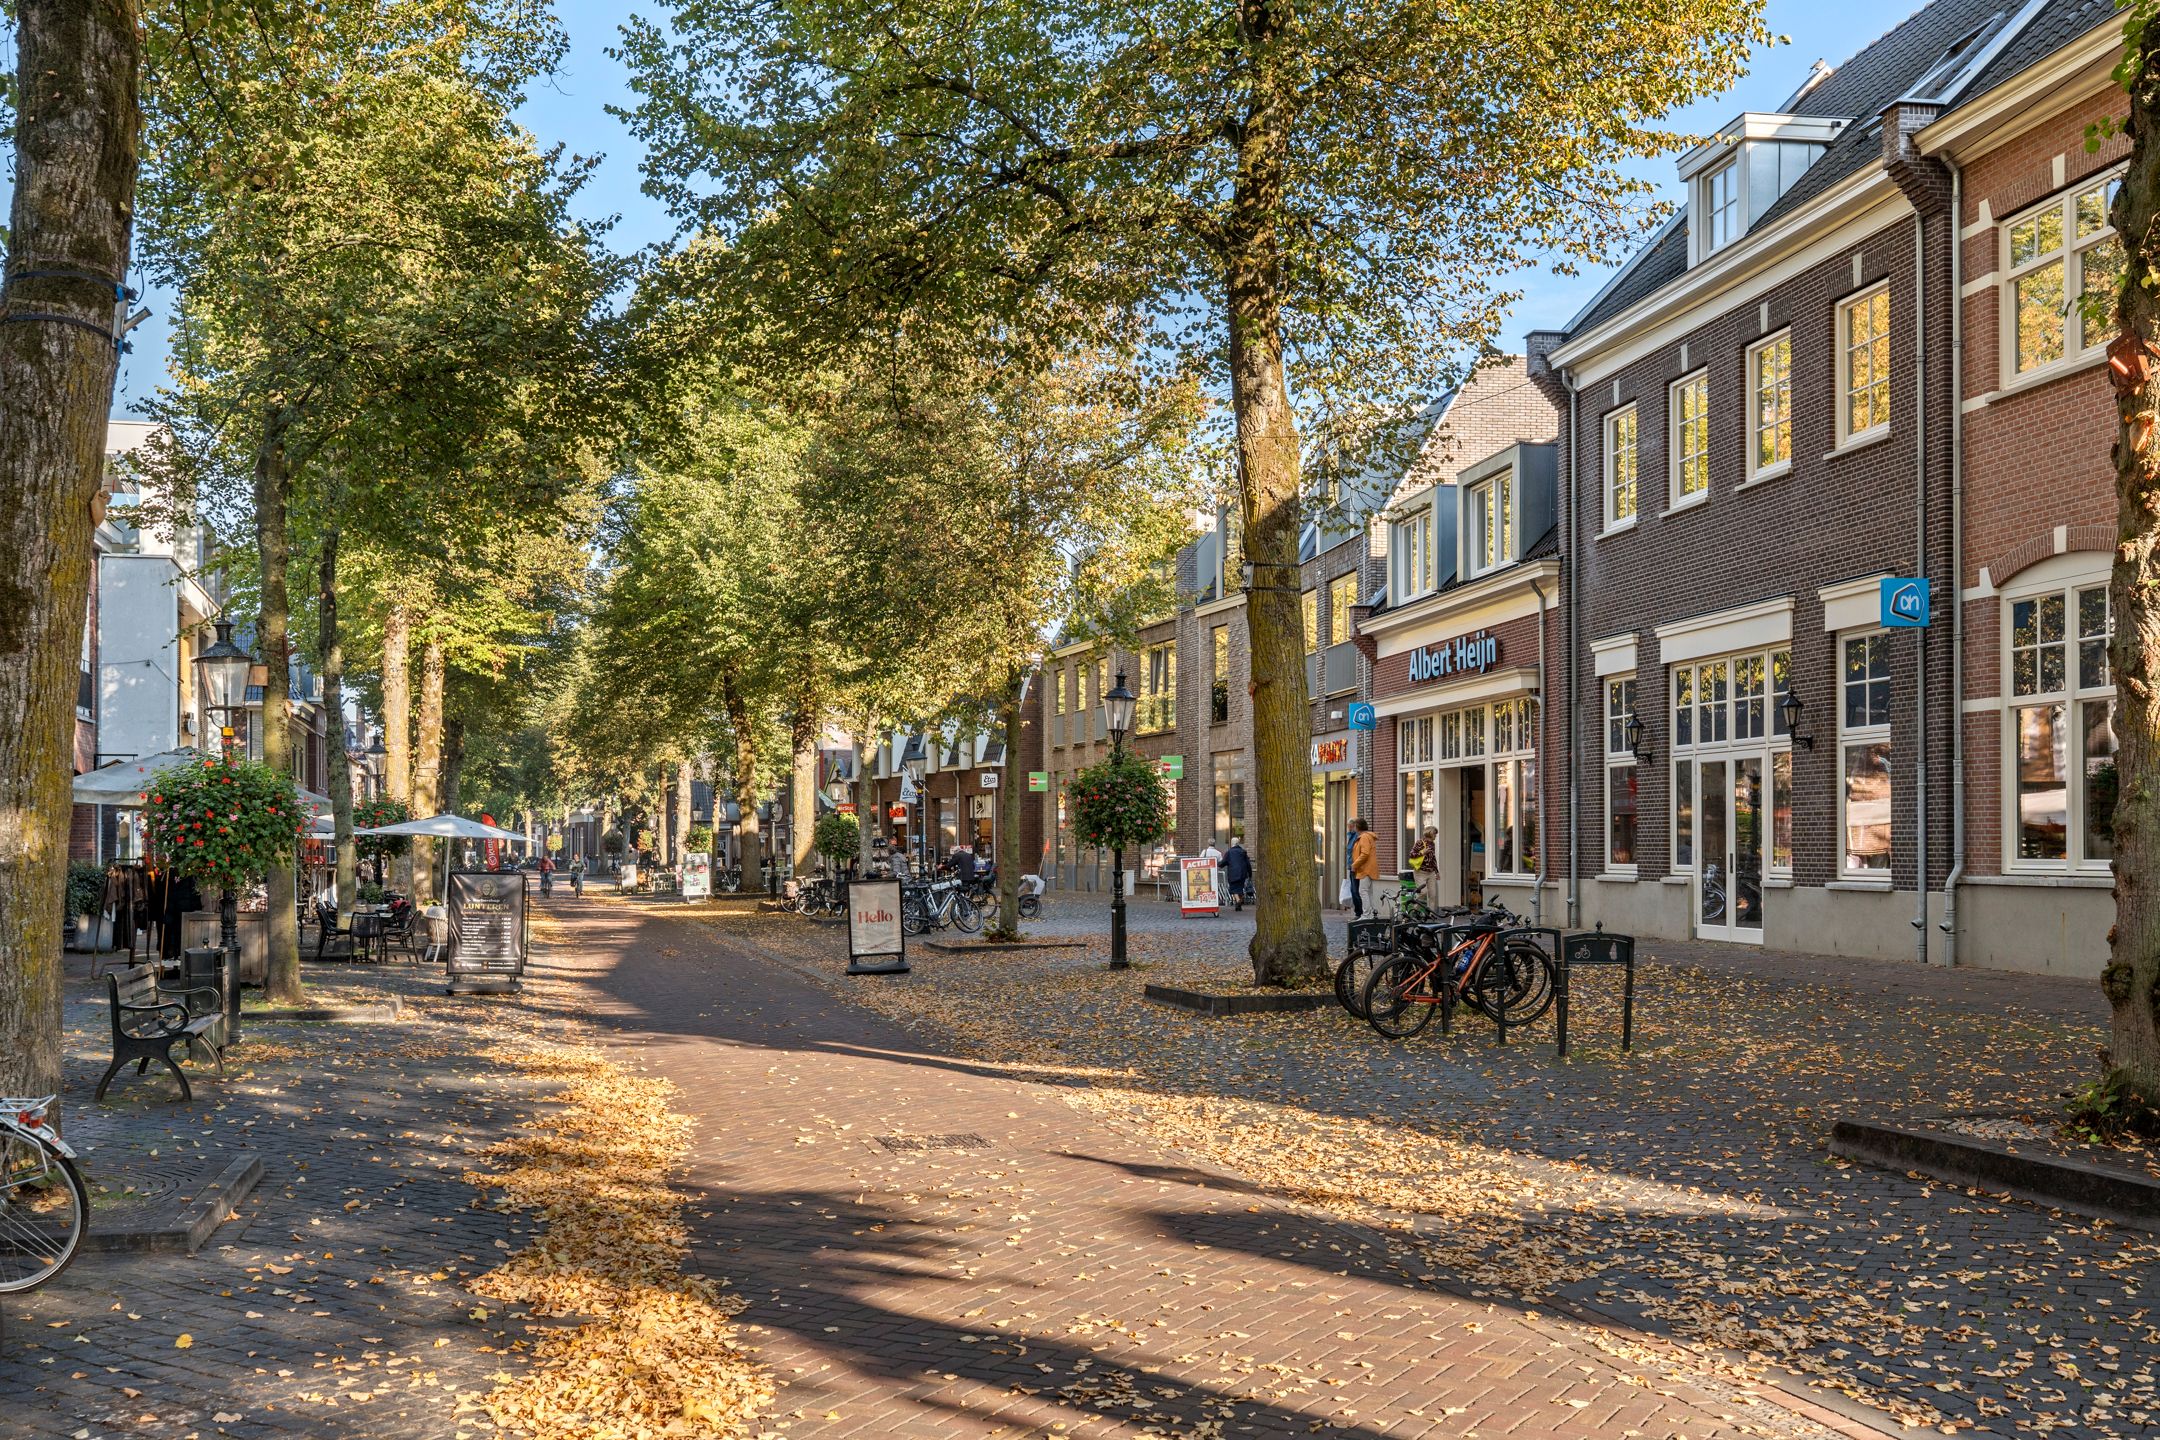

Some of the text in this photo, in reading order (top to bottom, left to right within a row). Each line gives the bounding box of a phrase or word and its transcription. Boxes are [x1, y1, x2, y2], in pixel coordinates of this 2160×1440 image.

[1408, 630, 1497, 681] Albert Heijn
[983, 775, 997, 786] Etos
[857, 909, 893, 924] Hello
